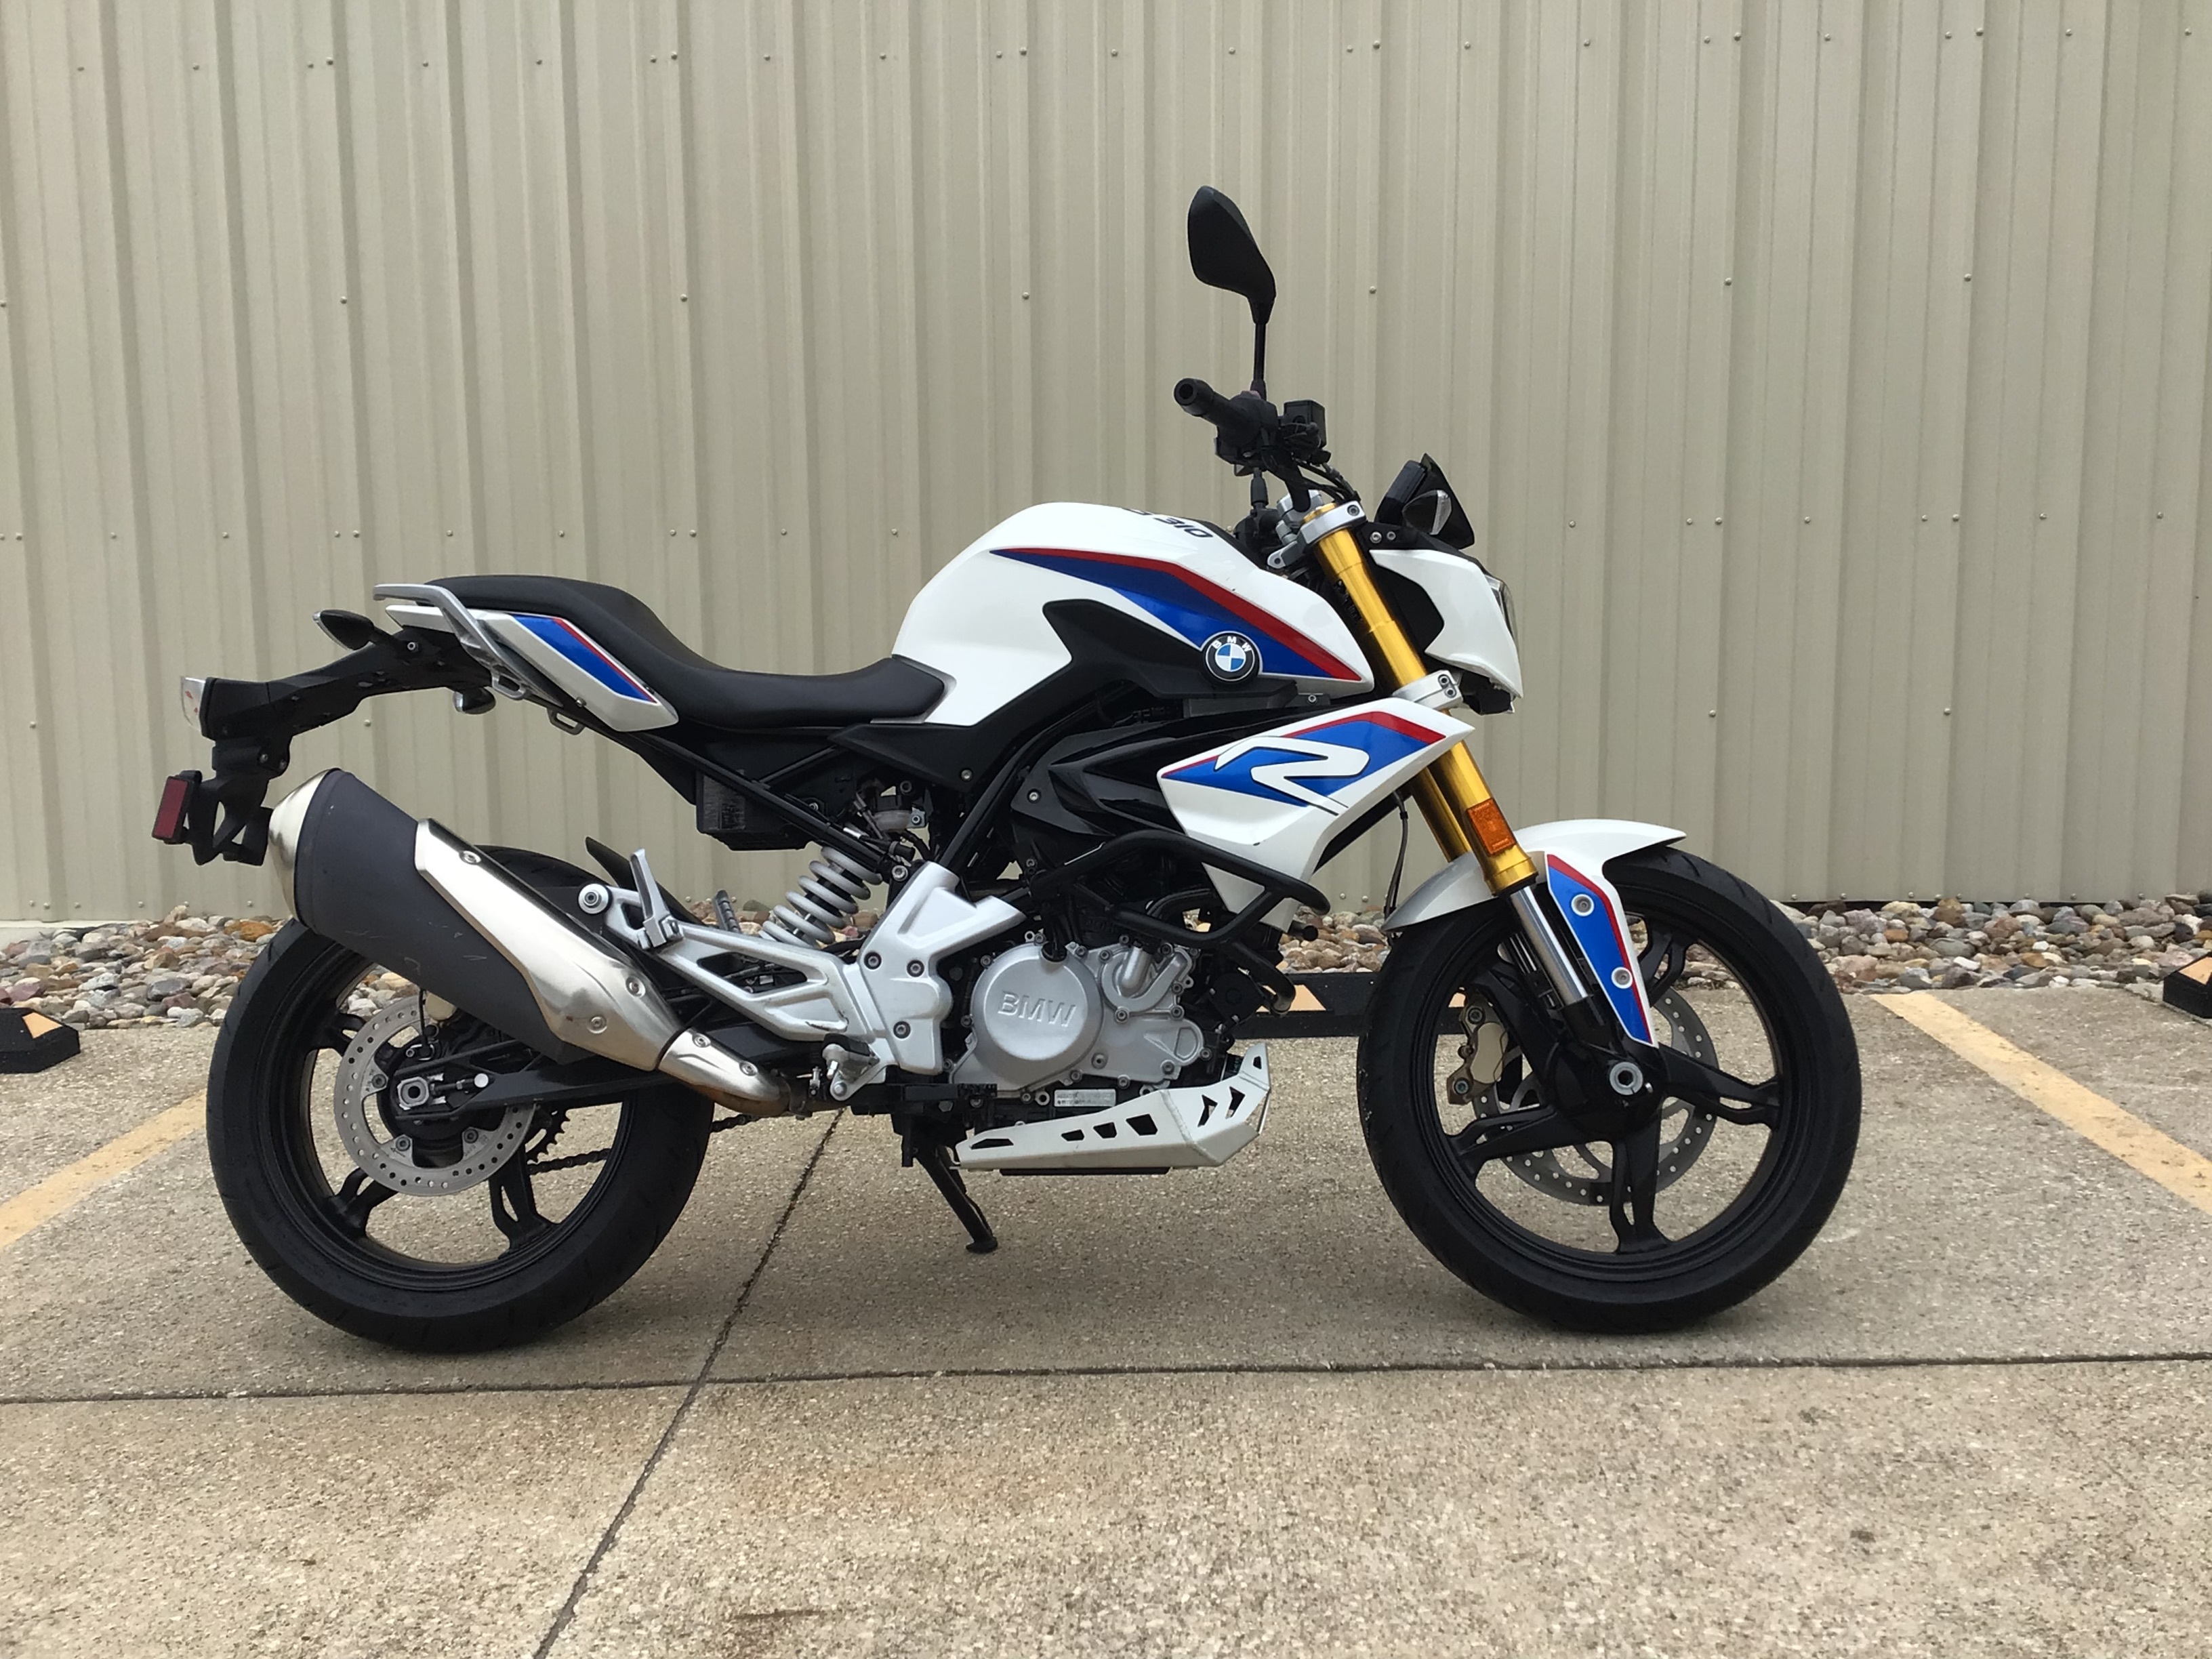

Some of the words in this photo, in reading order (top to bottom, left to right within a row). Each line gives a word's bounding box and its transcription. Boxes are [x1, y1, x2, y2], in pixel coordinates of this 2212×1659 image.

[1153, 517, 1214, 537] 310
[1211, 636, 1252, 652] BMW
[998, 991, 1077, 1027] BMW
